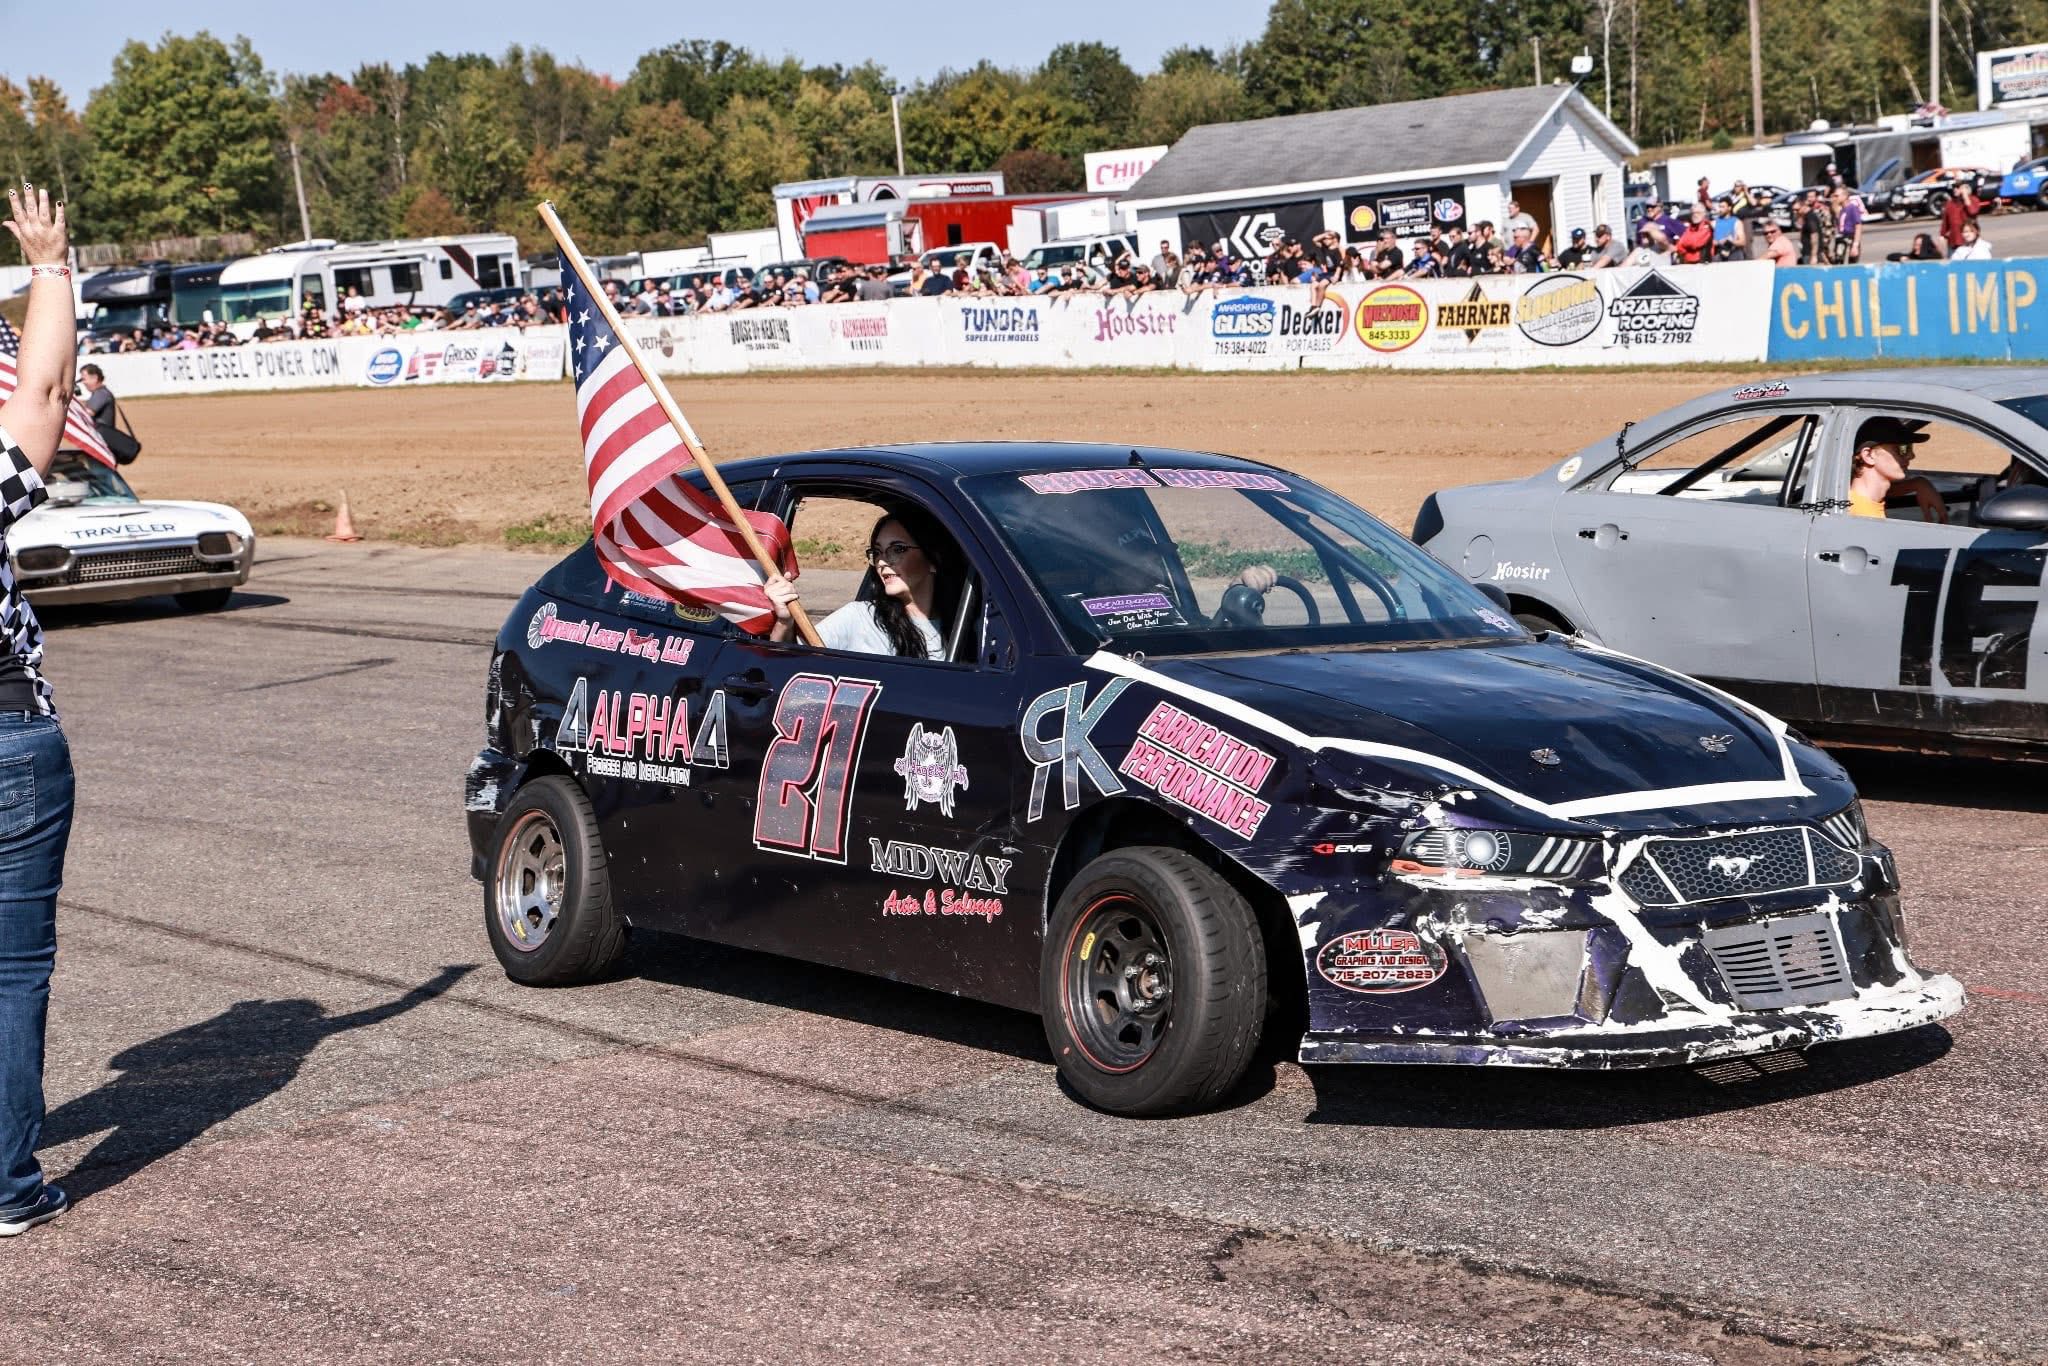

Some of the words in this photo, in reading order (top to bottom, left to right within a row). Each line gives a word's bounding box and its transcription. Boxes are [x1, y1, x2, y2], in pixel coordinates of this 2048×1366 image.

[1096, 160, 1159, 185] CHIL
[952, 183, 993, 194] ASSOCIATES
[1217, 302, 1268, 312] MARSHFIELD
[1436, 303, 1511, 327] FAHRNER
[1610, 297, 1699, 316] DRAEGER
[1779, 275, 1919, 340] CHILI
[961, 307, 1039, 332] TUNDRA
[1094, 307, 1177, 342] Hoosier
[1213, 312, 1273, 335] GLASS
[1280, 303, 1343, 336] Decker
[1618, 313, 1696, 331] ROOFING
[964, 333, 988, 342] SUPER
[989, 333, 1006, 342] LATE
[1007, 333, 1040, 342] MODELS
[1286, 338, 1331, 352] PORTABLES
[1369, 330, 1410, 340] 845-3333
[1612, 333, 1693, 345] 715-615-2792
[162, 356, 194, 380] PURE
[199, 352, 249, 379] DIESEL
[255, 350, 305, 377] POWER
[72, 523, 177, 540] TRAVELER
[1491, 561, 1551, 581] Hoosier
[585, 621, 625, 652] Laser
[660, 635, 695, 666] LLC
[587, 689, 692, 764] ALPHA
[1137, 700, 1278, 795] FABRICATION
[587, 754, 621, 777] PROCESS
[621, 760, 637, 779] AND
[638, 759, 691, 787] INSTALLATION
[752, 671, 884, 866] 21
[1118, 735, 1272, 842] PERFORMANCE
[868, 837, 1013, 895] MIDWAY
[883, 889, 921, 916] Auto
[923, 888, 937, 916] &
[941, 888, 1003, 923] Salvage
[1343, 934, 1421, 954] MILLER
[1336, 955, 1377, 966] GRAPHICS
[1378, 955, 1397, 965] AND
[1398, 955, 1428, 965] DESIGN
[1334, 970, 1434, 981] 715-207-2823
